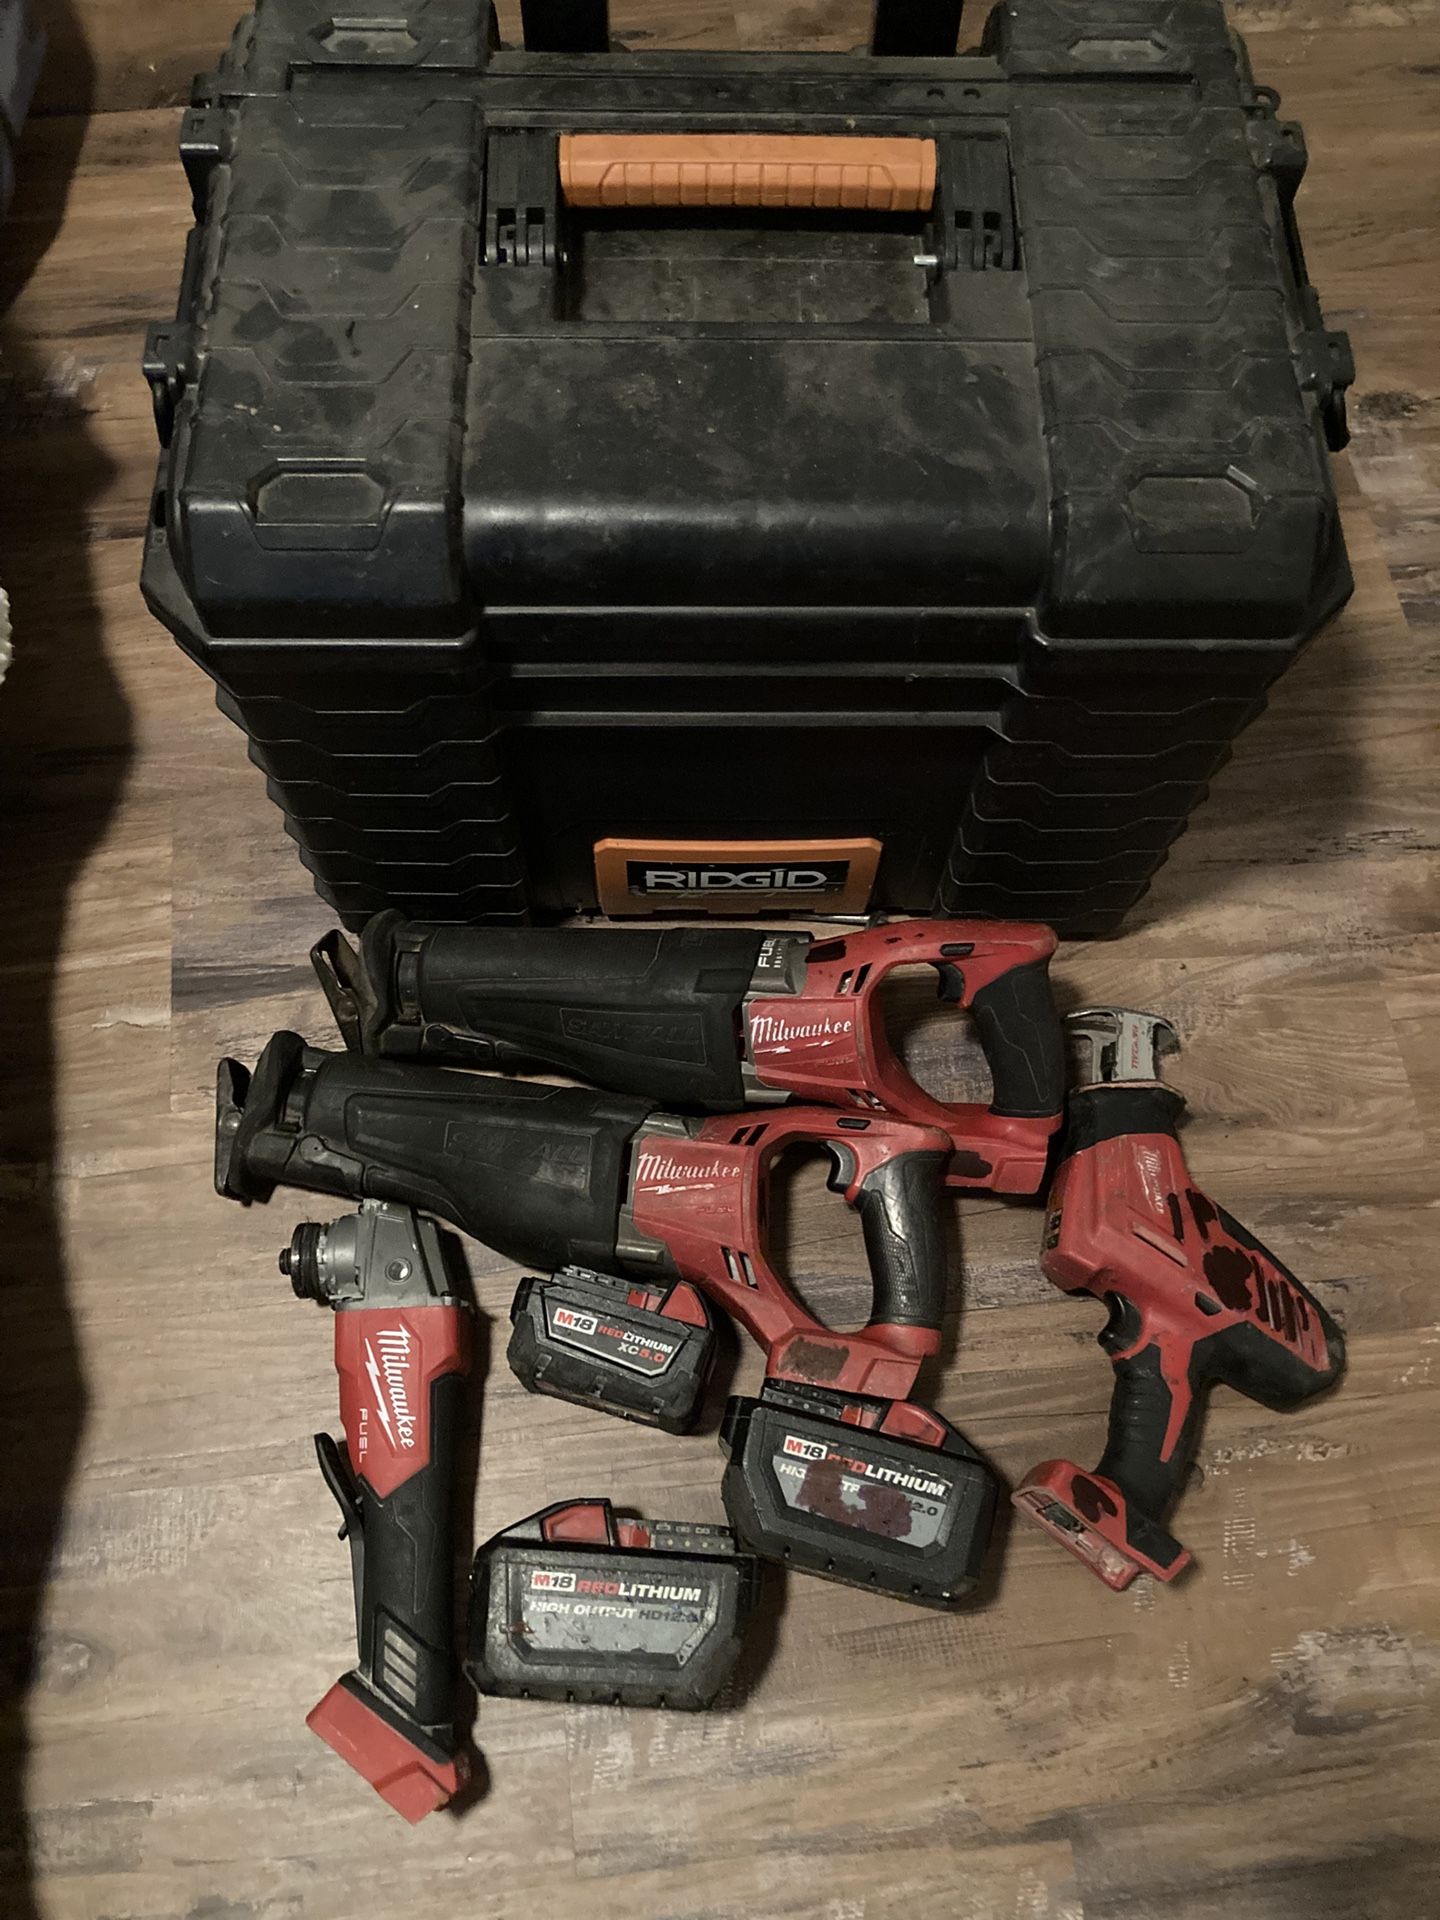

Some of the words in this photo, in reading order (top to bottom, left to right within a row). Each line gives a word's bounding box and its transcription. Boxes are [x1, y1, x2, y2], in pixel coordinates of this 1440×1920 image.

[645, 867, 828, 888] RIDGID
[750, 1014, 852, 1044] Milwaukee
[635, 1152, 741, 1182] Milwaukee
[556, 1310, 595, 1332] M18
[596, 1325, 674, 1355] REDLITHIUM
[616, 1342, 666, 1363] XC5.0
[376, 1323, 416, 1450] Milwaukee
[358, 1408, 368, 1464] FUEL
[785, 1439, 824, 1459] M18
[779, 1463, 807, 1480] HIG
[533, 1574, 573, 1590] M18
[576, 1580, 702, 1602] REDLITHIUM
[529, 1601, 570, 1615] HIGH
[573, 1604, 638, 1619] OUTPUT
